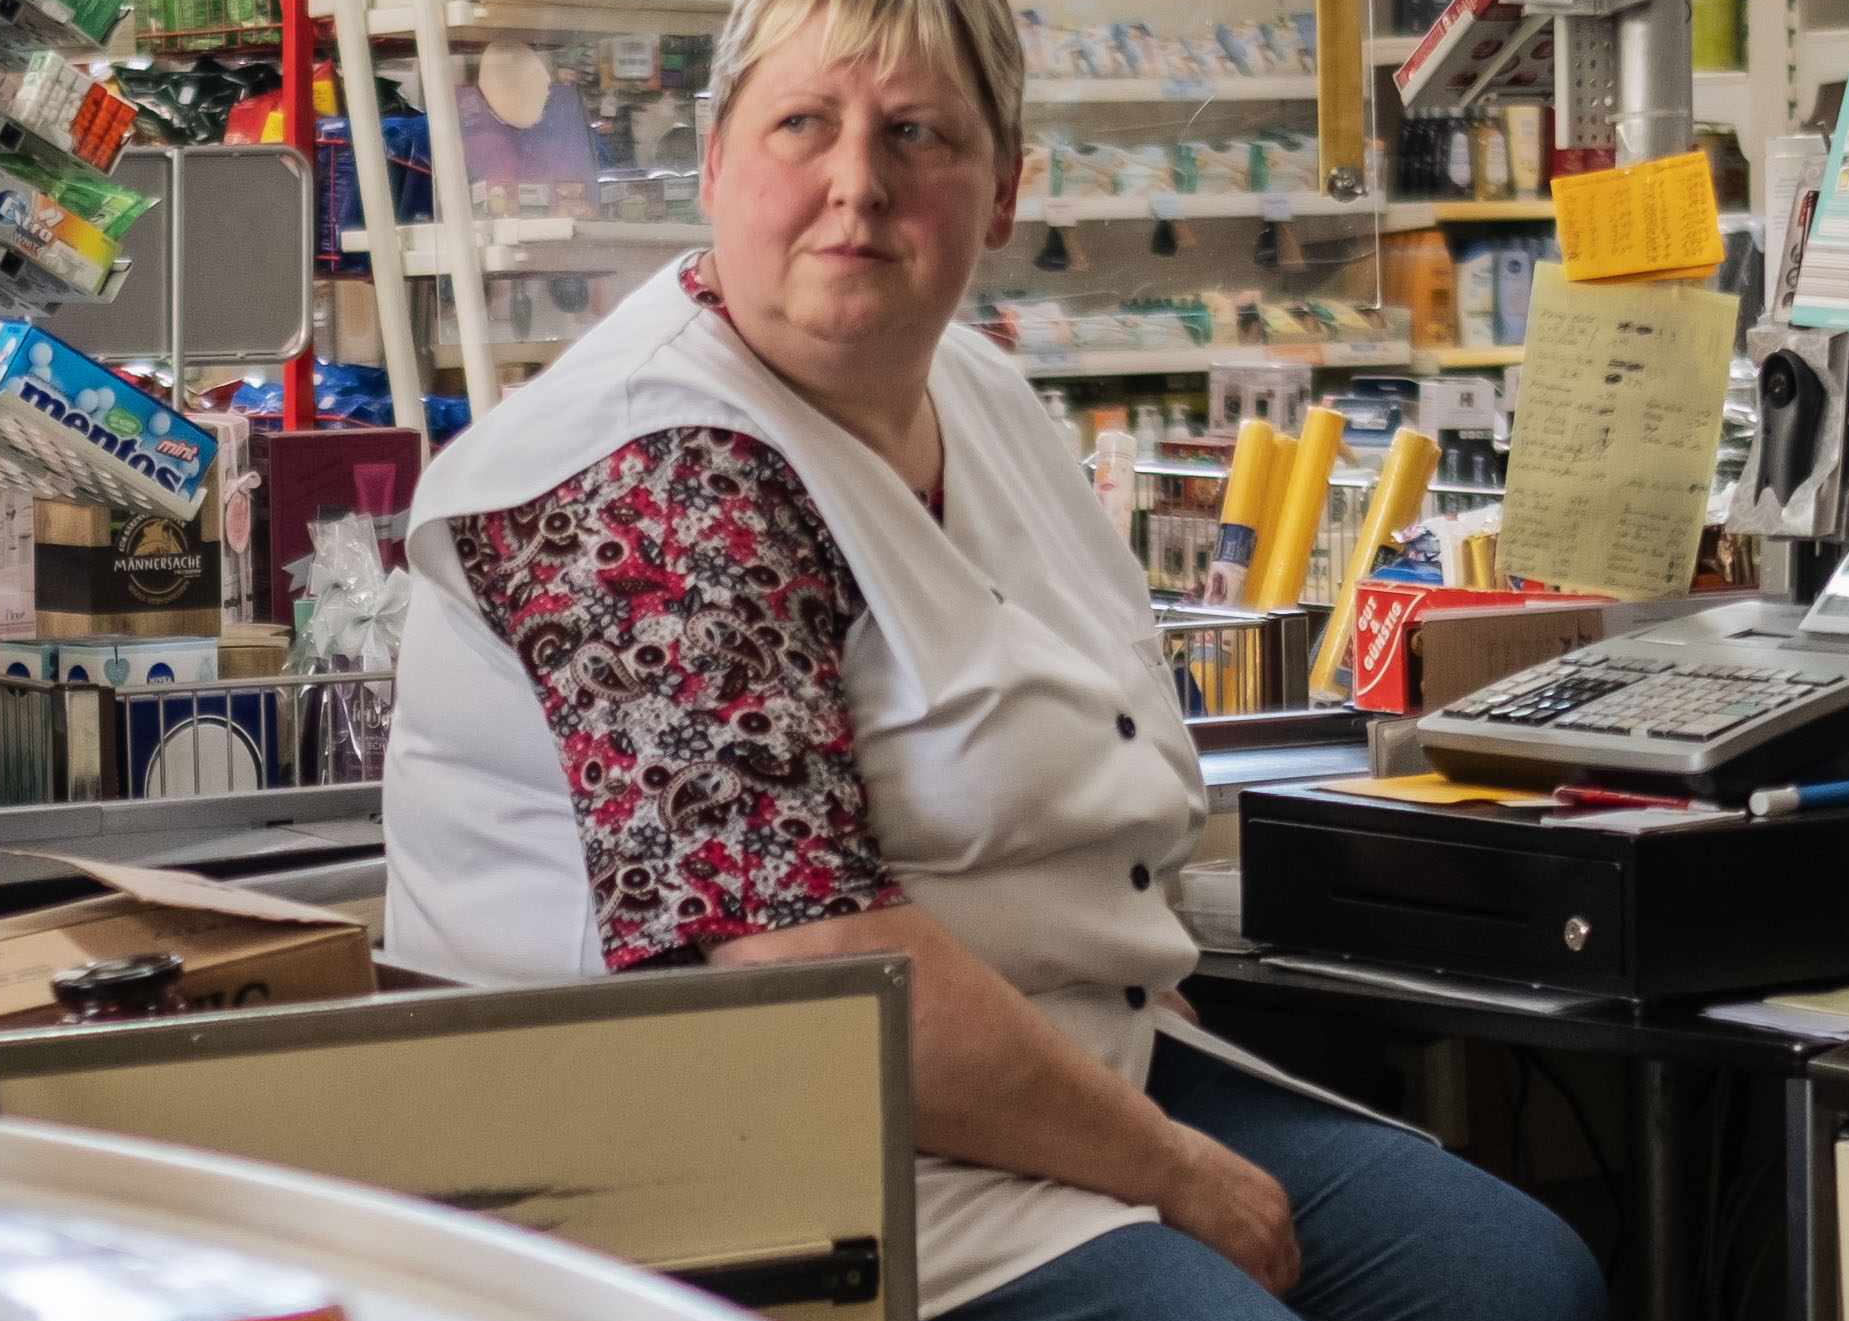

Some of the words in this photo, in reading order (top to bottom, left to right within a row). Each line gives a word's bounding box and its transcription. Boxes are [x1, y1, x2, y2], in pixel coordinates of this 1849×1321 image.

[20, 381, 182, 494] mentos
[156, 437, 200, 463] mint
[113, 555, 203, 573] MÄNNERSACHE
[1358, 596, 1378, 632] GUT
[1363, 601, 1403, 671] GÜNSTIG
